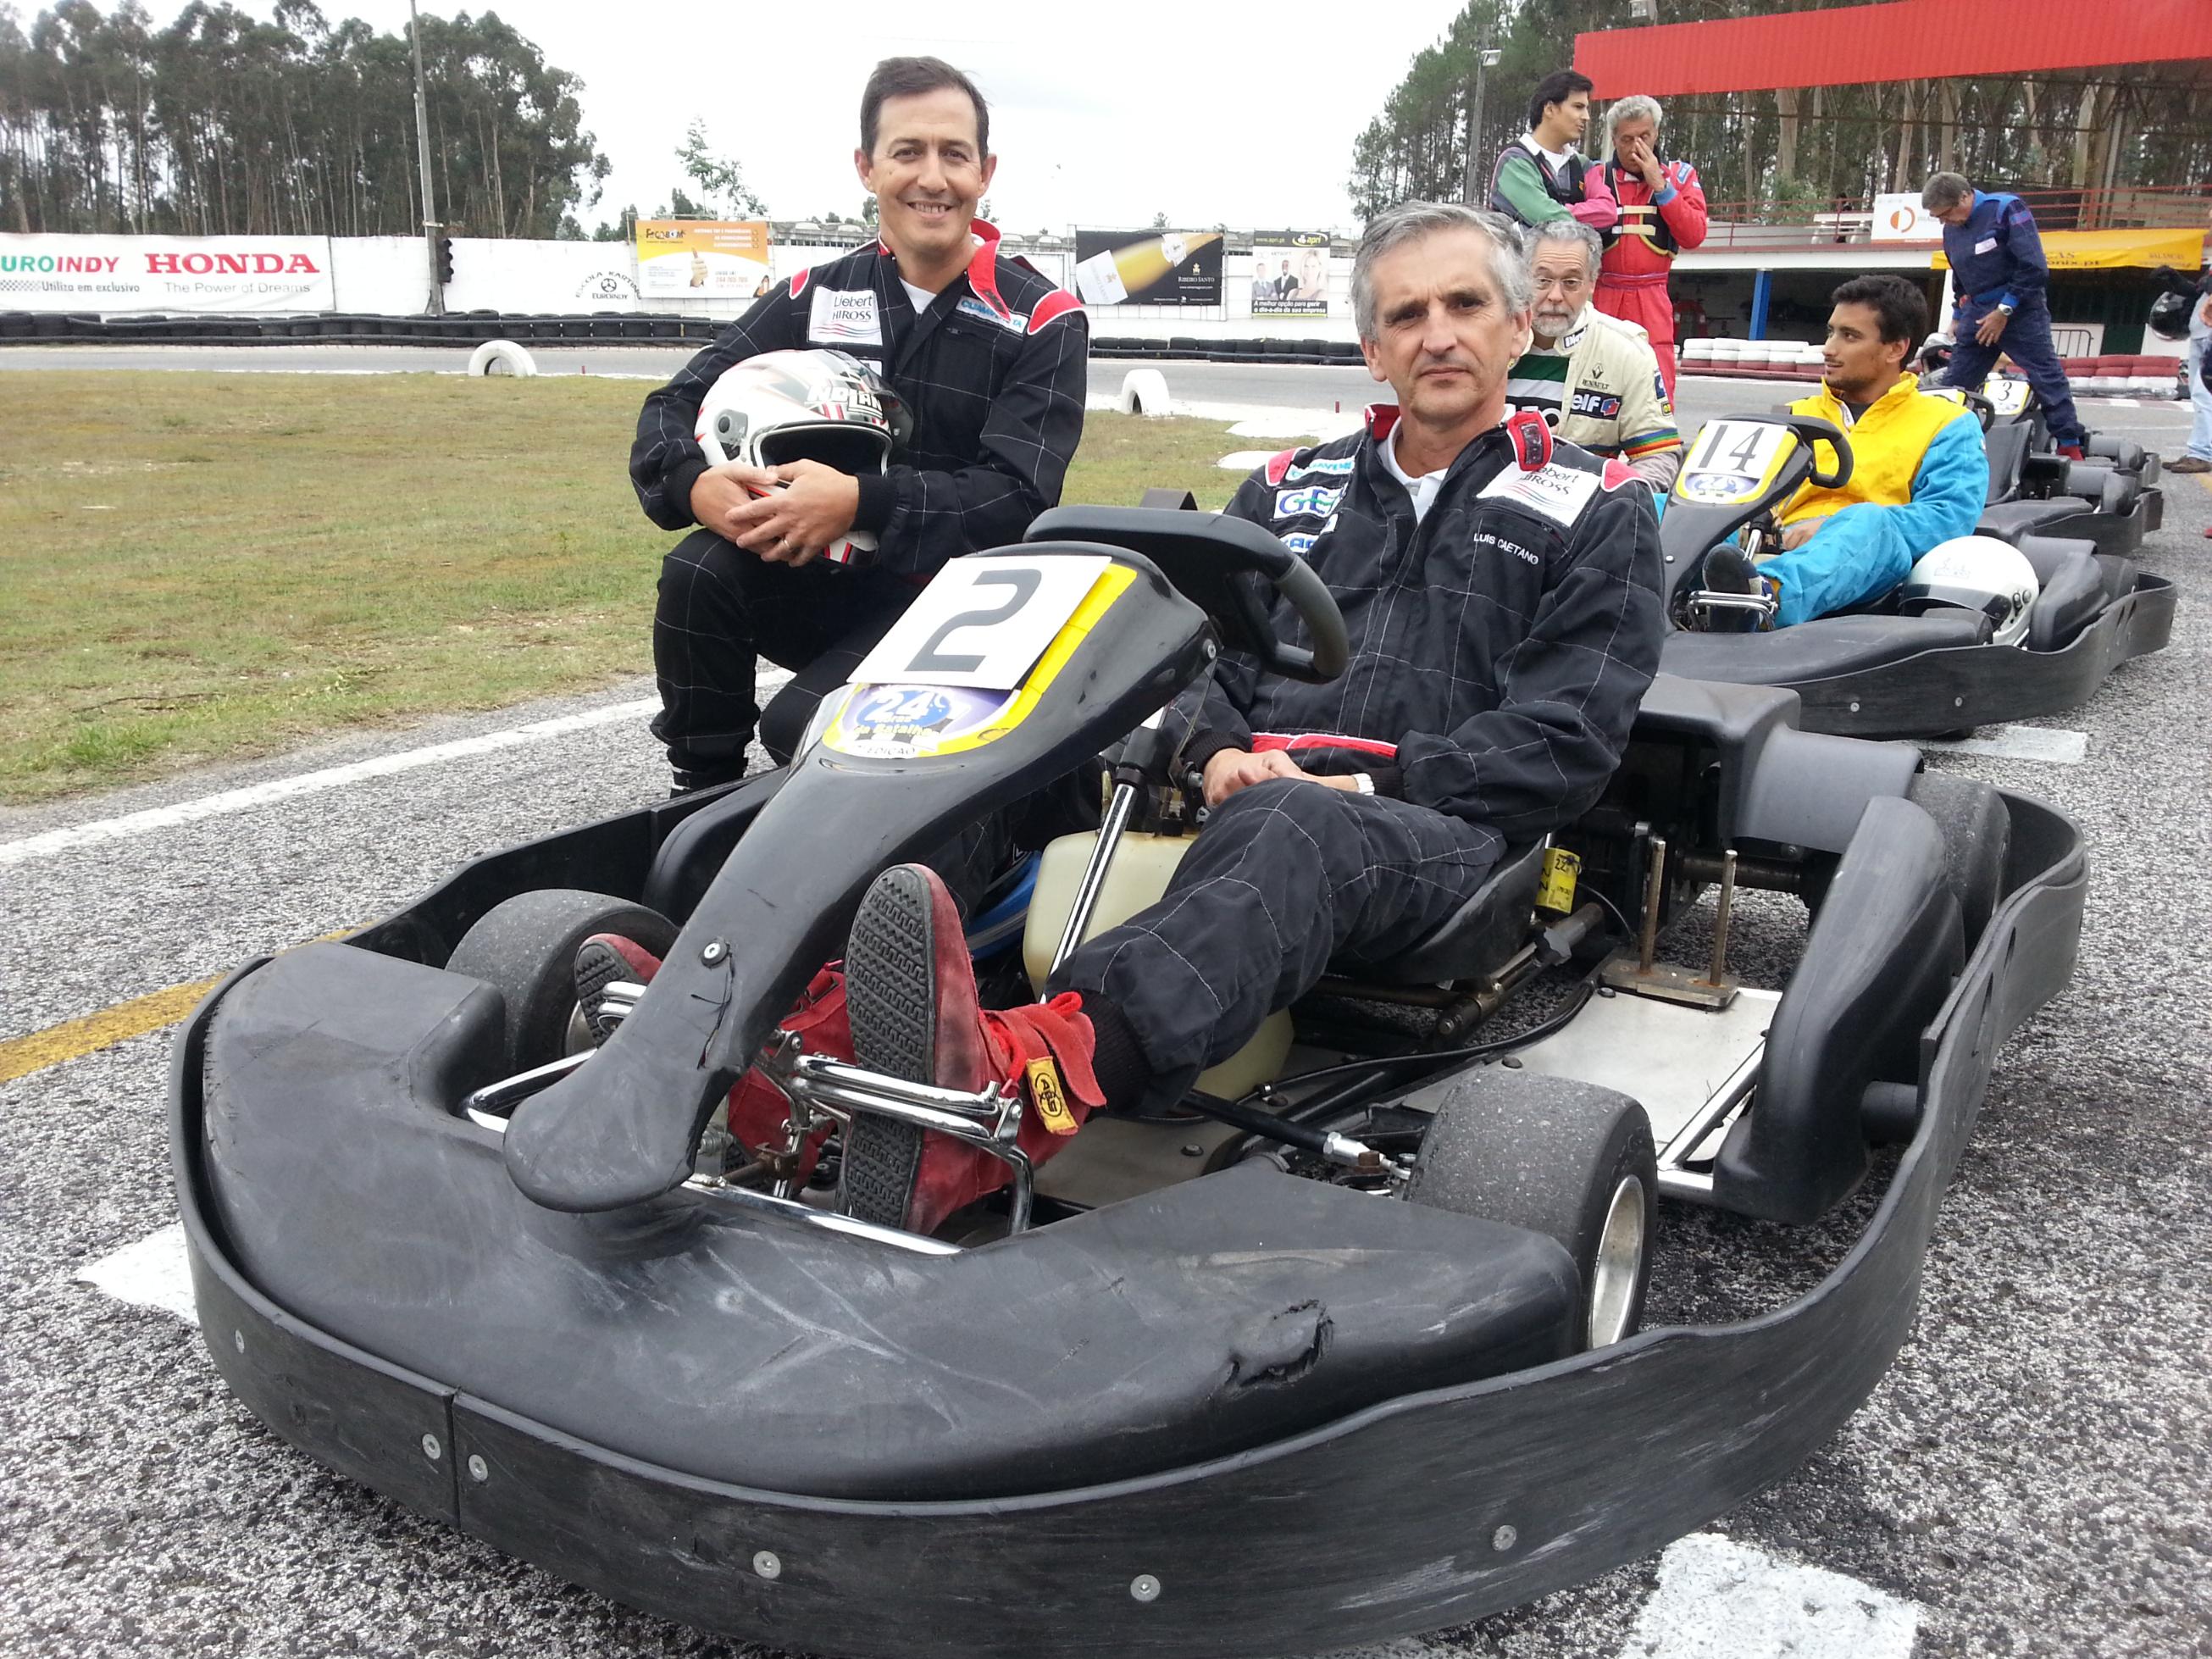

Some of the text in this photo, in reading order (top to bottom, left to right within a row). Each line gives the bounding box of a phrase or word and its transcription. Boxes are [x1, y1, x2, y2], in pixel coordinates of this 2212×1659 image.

[143, 252, 321, 275] HONDA
[42, 280, 74, 292] Utiliza
[96, 281, 141, 292] exclusivo
[164, 282, 311, 293] The Power of Dreams
[834, 294, 873, 308] Liebert
[832, 309, 872, 320] HIROSS
[1582, 379, 1610, 390] RENAULT
[1998, 381, 2013, 402] 3
[1572, 393, 1602, 413] elf
[1697, 424, 1766, 473] 14
[1497, 539, 1539, 565] CAETANO
[903, 569, 1043, 673] 2
[864, 690, 935, 721] 24
